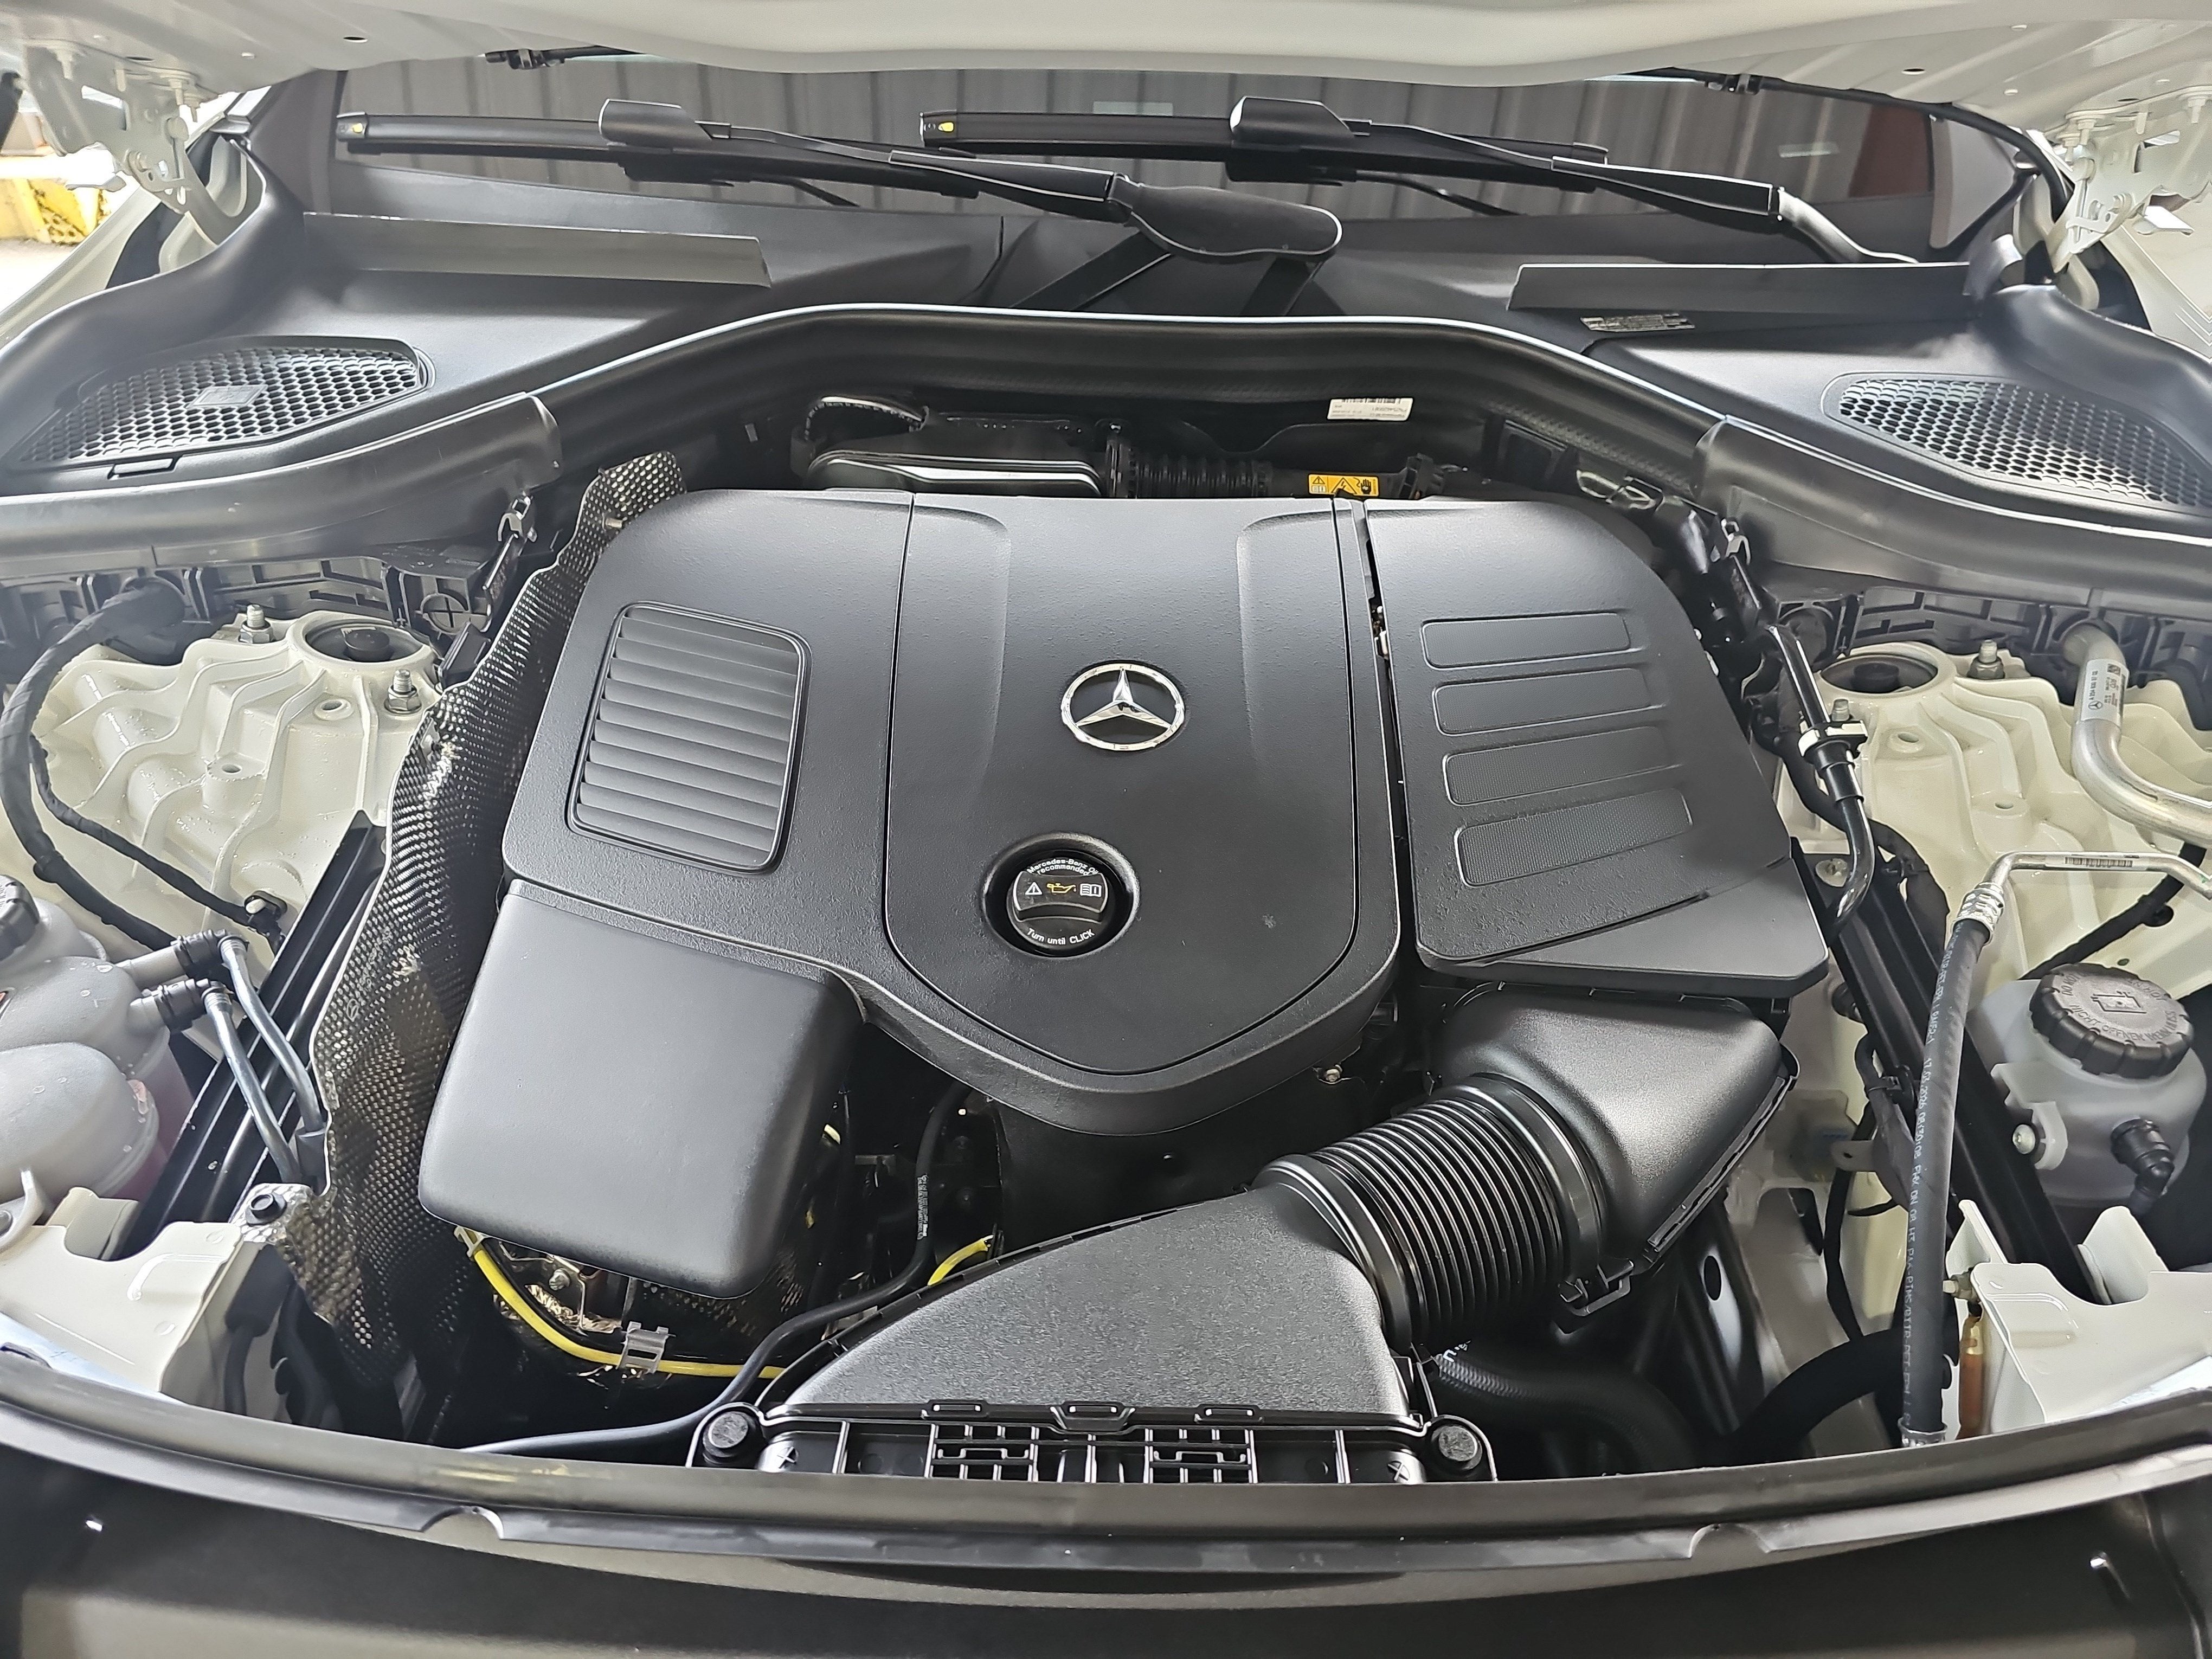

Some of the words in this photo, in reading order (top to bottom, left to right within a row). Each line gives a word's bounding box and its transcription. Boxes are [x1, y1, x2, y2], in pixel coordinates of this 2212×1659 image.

[1026, 858, 1088, 874] Mercedes-Benz
[1037, 864, 1090, 876] recommended
[1027, 928, 1045, 942] Turn
[1047, 937, 1066, 945] until
[1069, 929, 1095, 943] CLICK
[2061, 985, 2074, 996] DO
